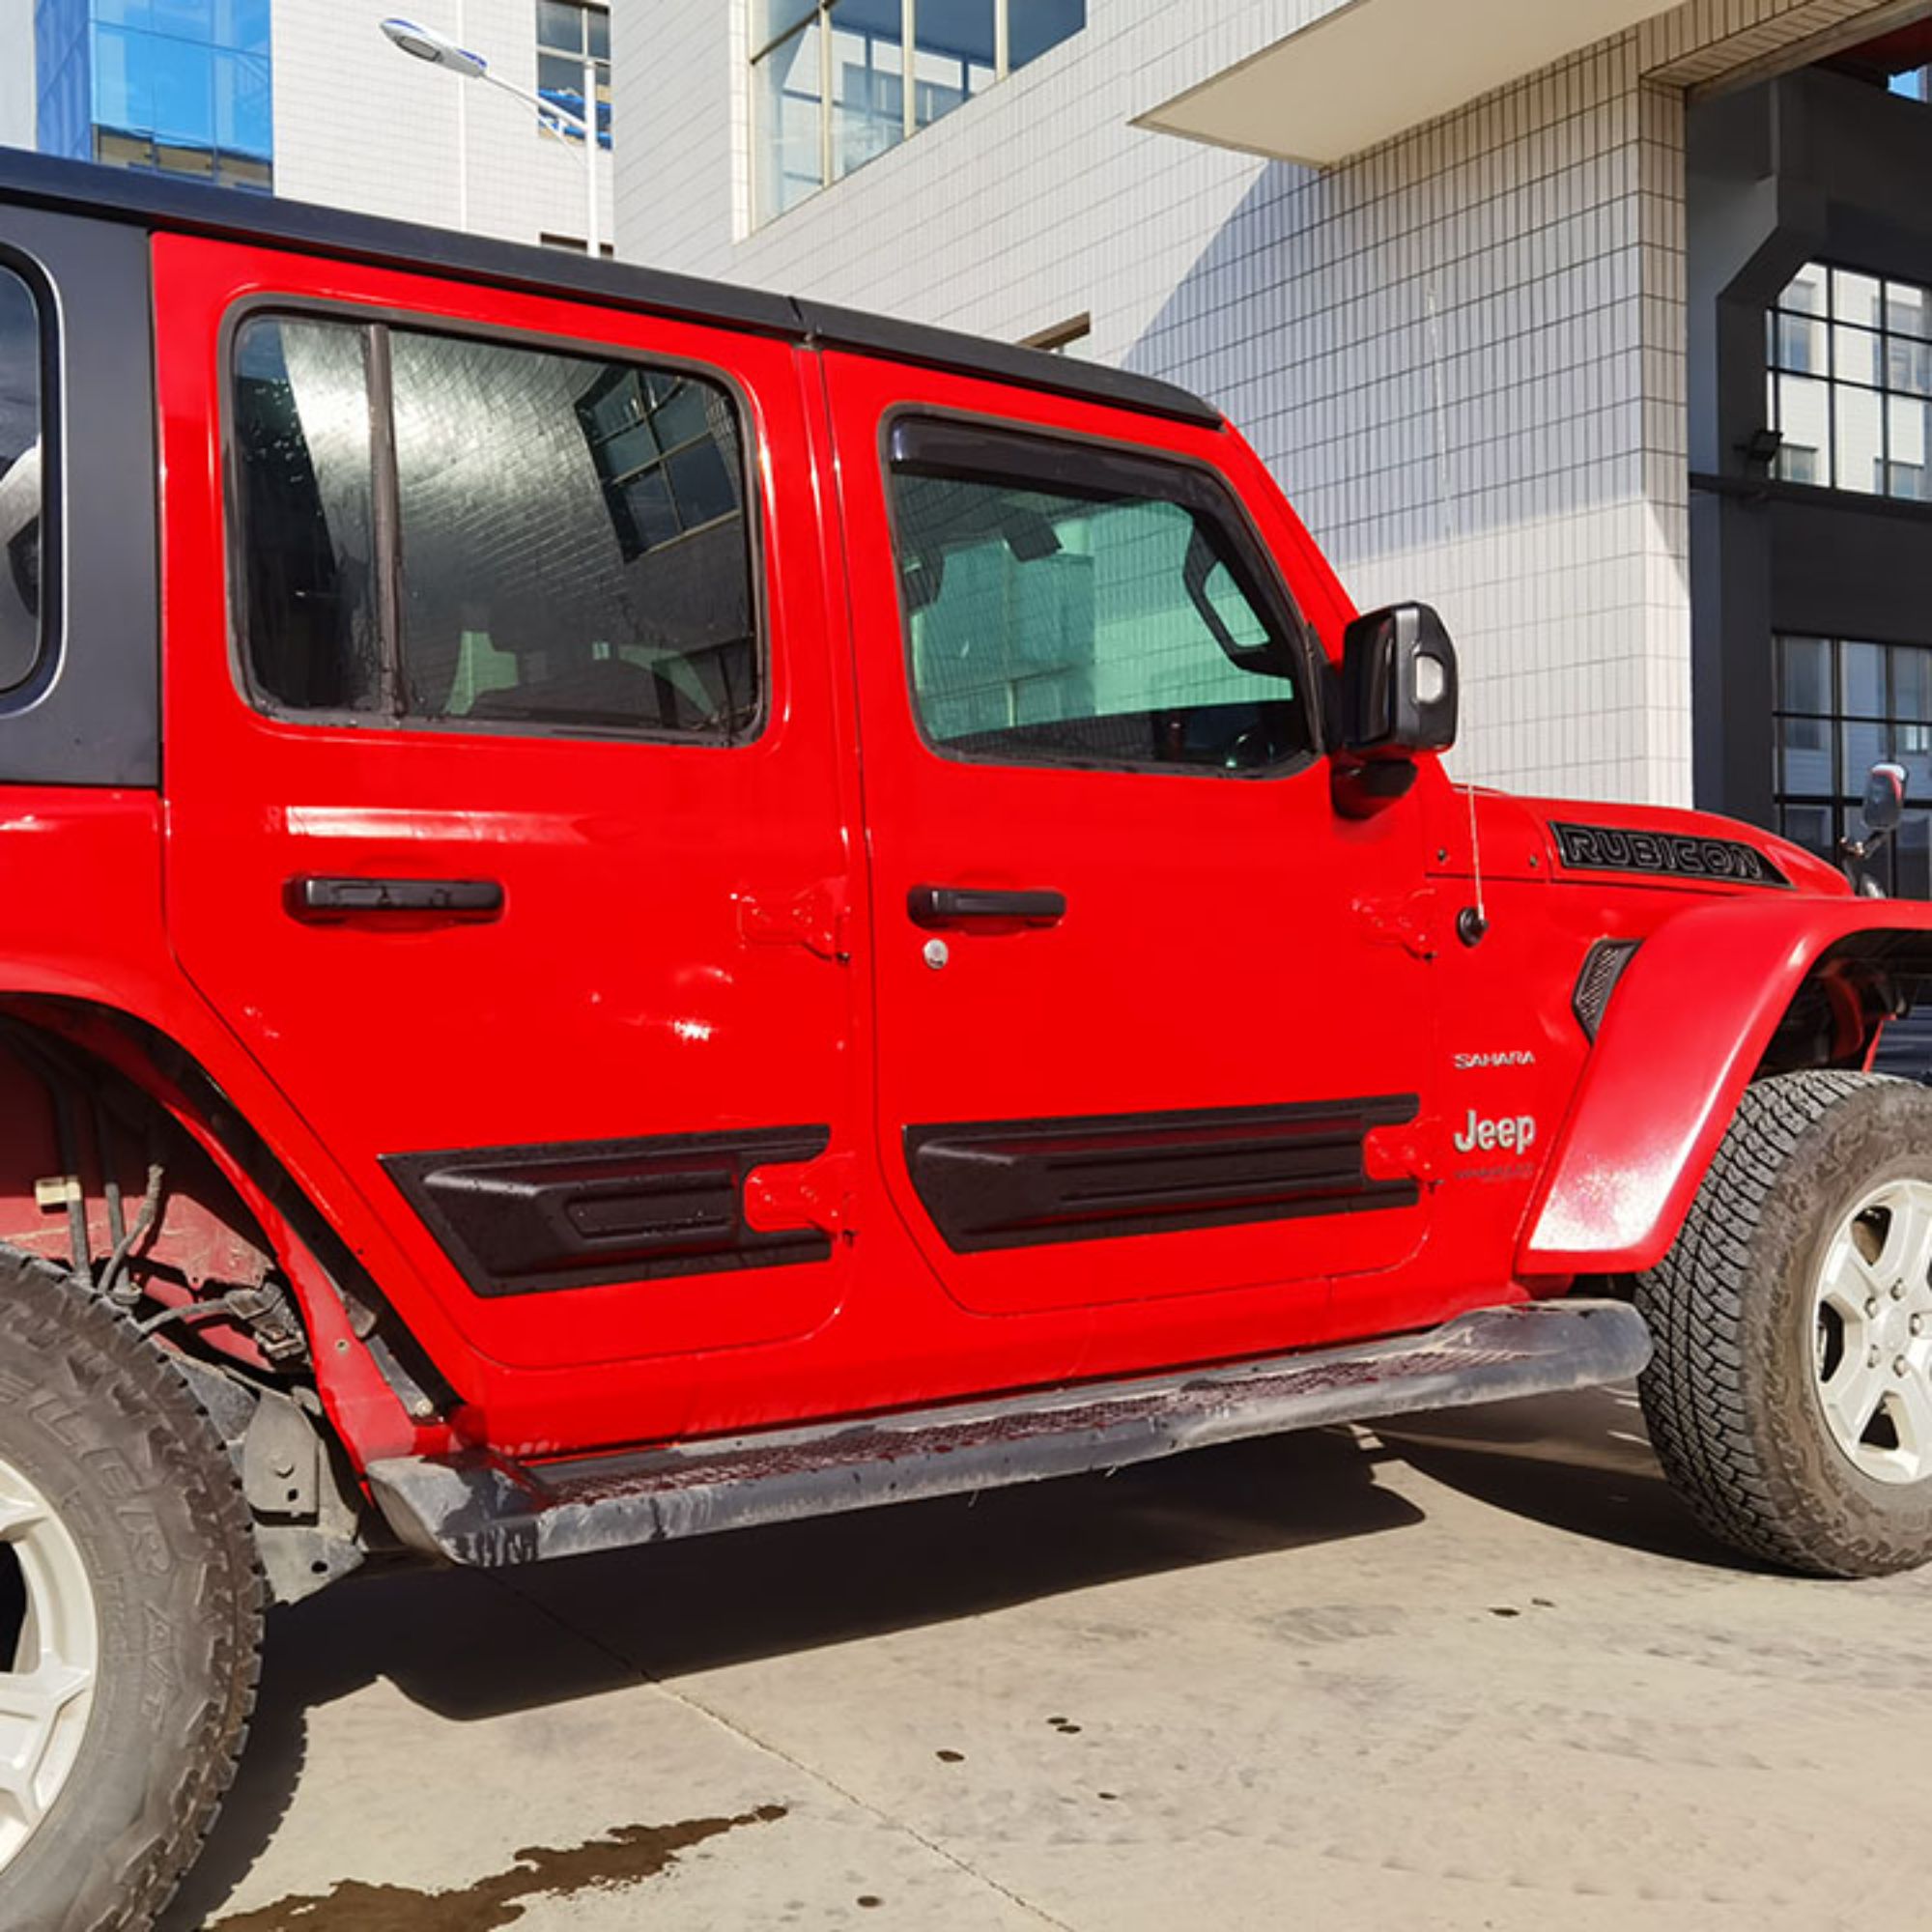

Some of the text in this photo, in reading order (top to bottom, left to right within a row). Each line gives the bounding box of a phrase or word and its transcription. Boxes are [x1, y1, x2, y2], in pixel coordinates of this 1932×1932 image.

[1560, 827, 1763, 879] RUBICON
[1454, 1050, 1535, 1069] SAHARA
[1454, 1110, 1535, 1155] Jeep
